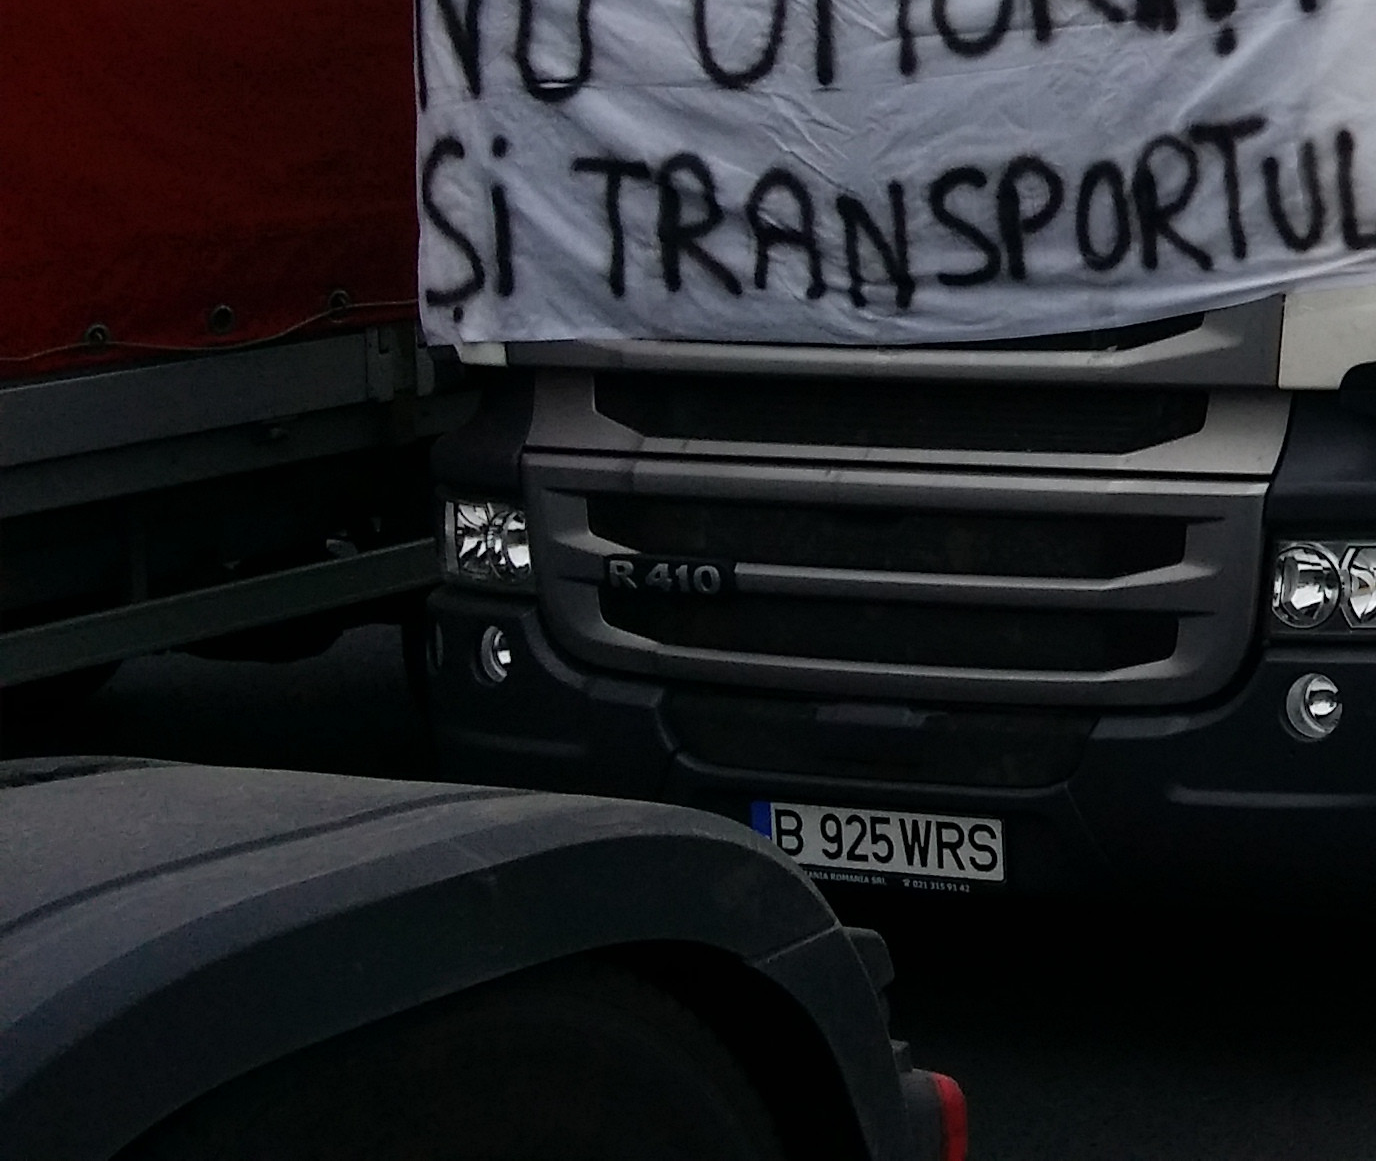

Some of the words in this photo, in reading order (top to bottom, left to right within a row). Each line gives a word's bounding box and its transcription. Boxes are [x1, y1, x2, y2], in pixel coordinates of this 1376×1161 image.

[609, 560, 638, 588] R
[644, 562, 721, 594] 410
[775, 808, 804, 857] B
[912, 880, 928, 889] 021
